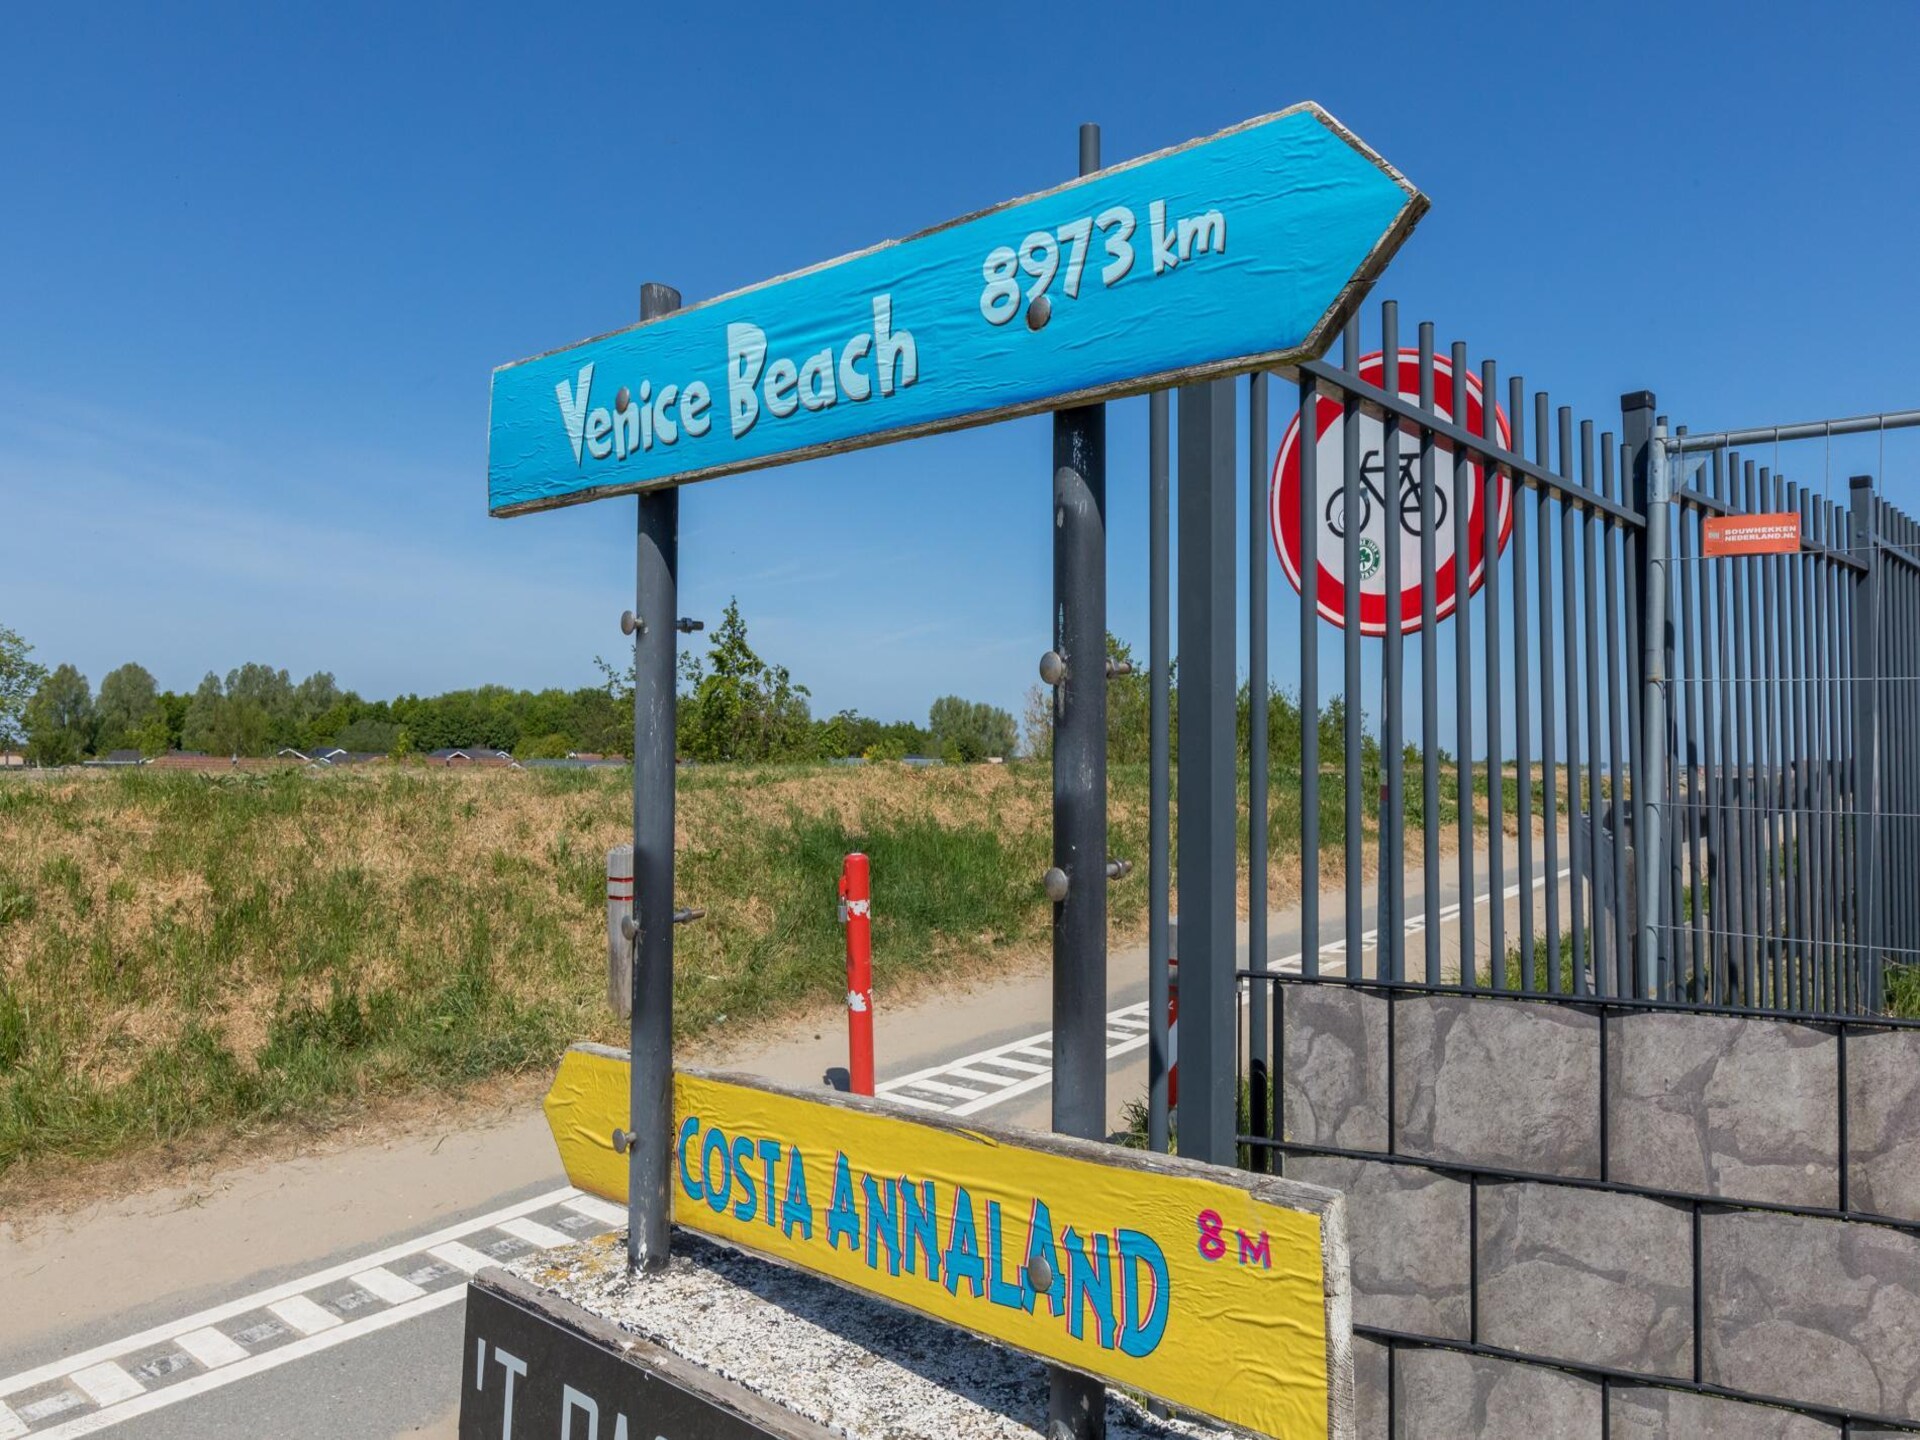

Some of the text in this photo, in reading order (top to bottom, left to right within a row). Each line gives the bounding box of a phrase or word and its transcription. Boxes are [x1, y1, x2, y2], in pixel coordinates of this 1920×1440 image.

[555, 199, 1225, 468] Venice Beach 8973 km
[1724, 525, 1797, 536] BOUWHEKKEN
[1724, 531, 1796, 542] NEDERLAND.NL
[677, 1116, 1272, 1358] COSTA ANNALAND 8 M
